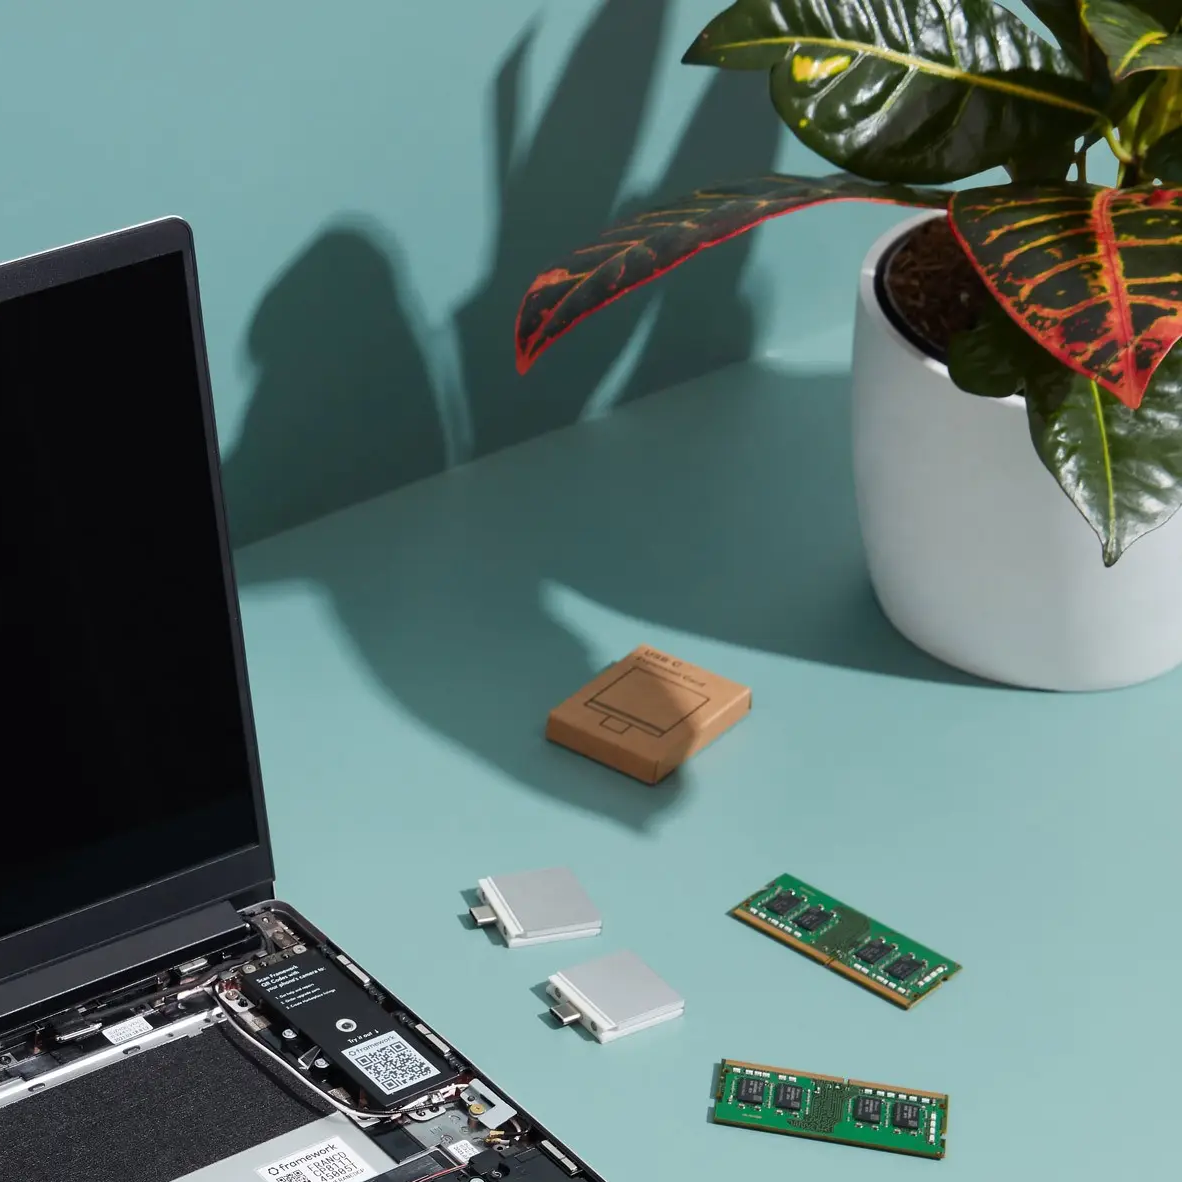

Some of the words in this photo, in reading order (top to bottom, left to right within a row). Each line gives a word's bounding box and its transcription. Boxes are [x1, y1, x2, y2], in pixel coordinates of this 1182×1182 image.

[278, 1143, 338, 1172] framework
[306, 1151, 347, 1172] FRANCD
[312, 1157, 352, 1177] CP8111
